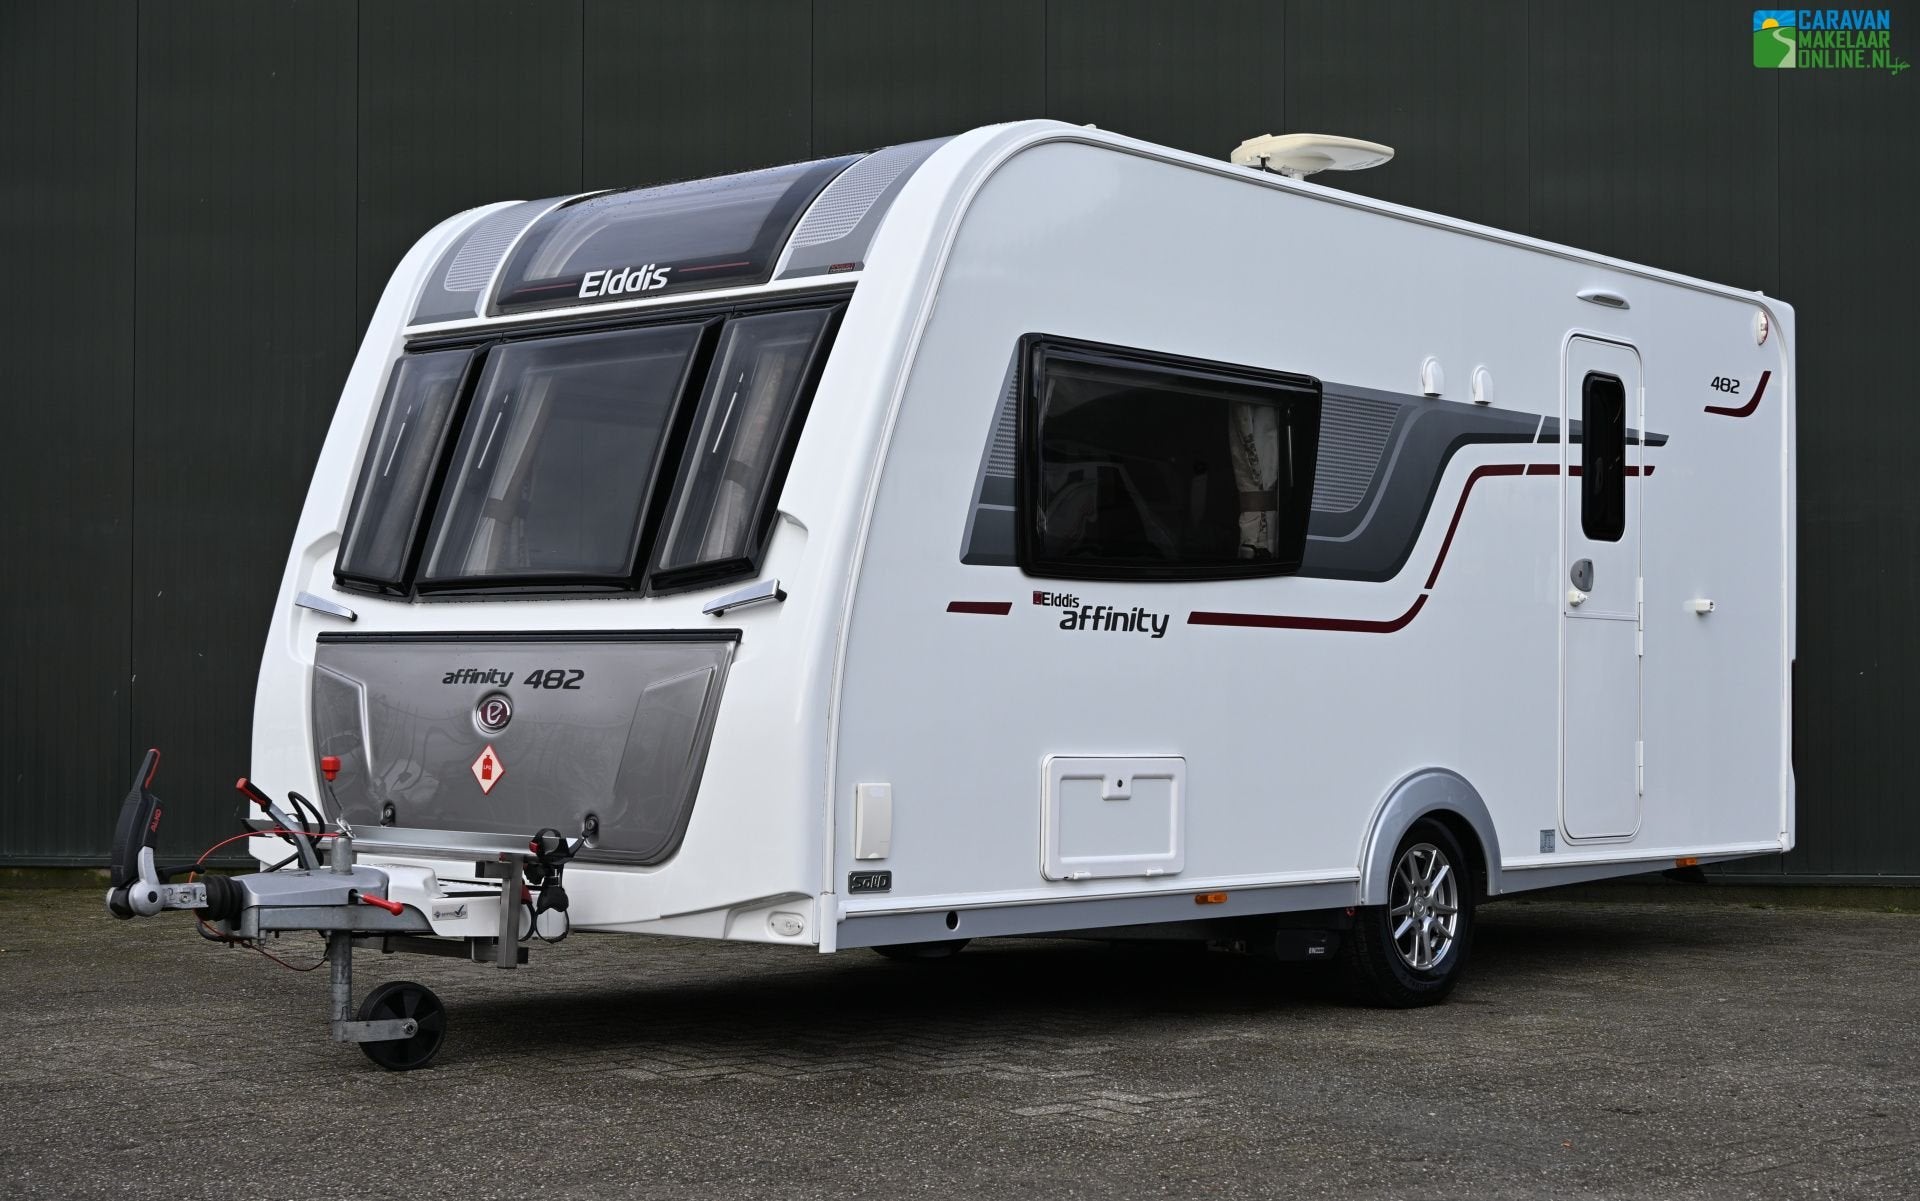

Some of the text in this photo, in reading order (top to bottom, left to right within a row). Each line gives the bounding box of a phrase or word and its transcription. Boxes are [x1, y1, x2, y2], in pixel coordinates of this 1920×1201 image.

[579, 263, 672, 299] Elddis
[1710, 376, 1740, 394] 482
[1042, 591, 1080, 608] Elddis
[1060, 605, 1170, 639] affinity
[442, 668, 585, 690] affinity 482
